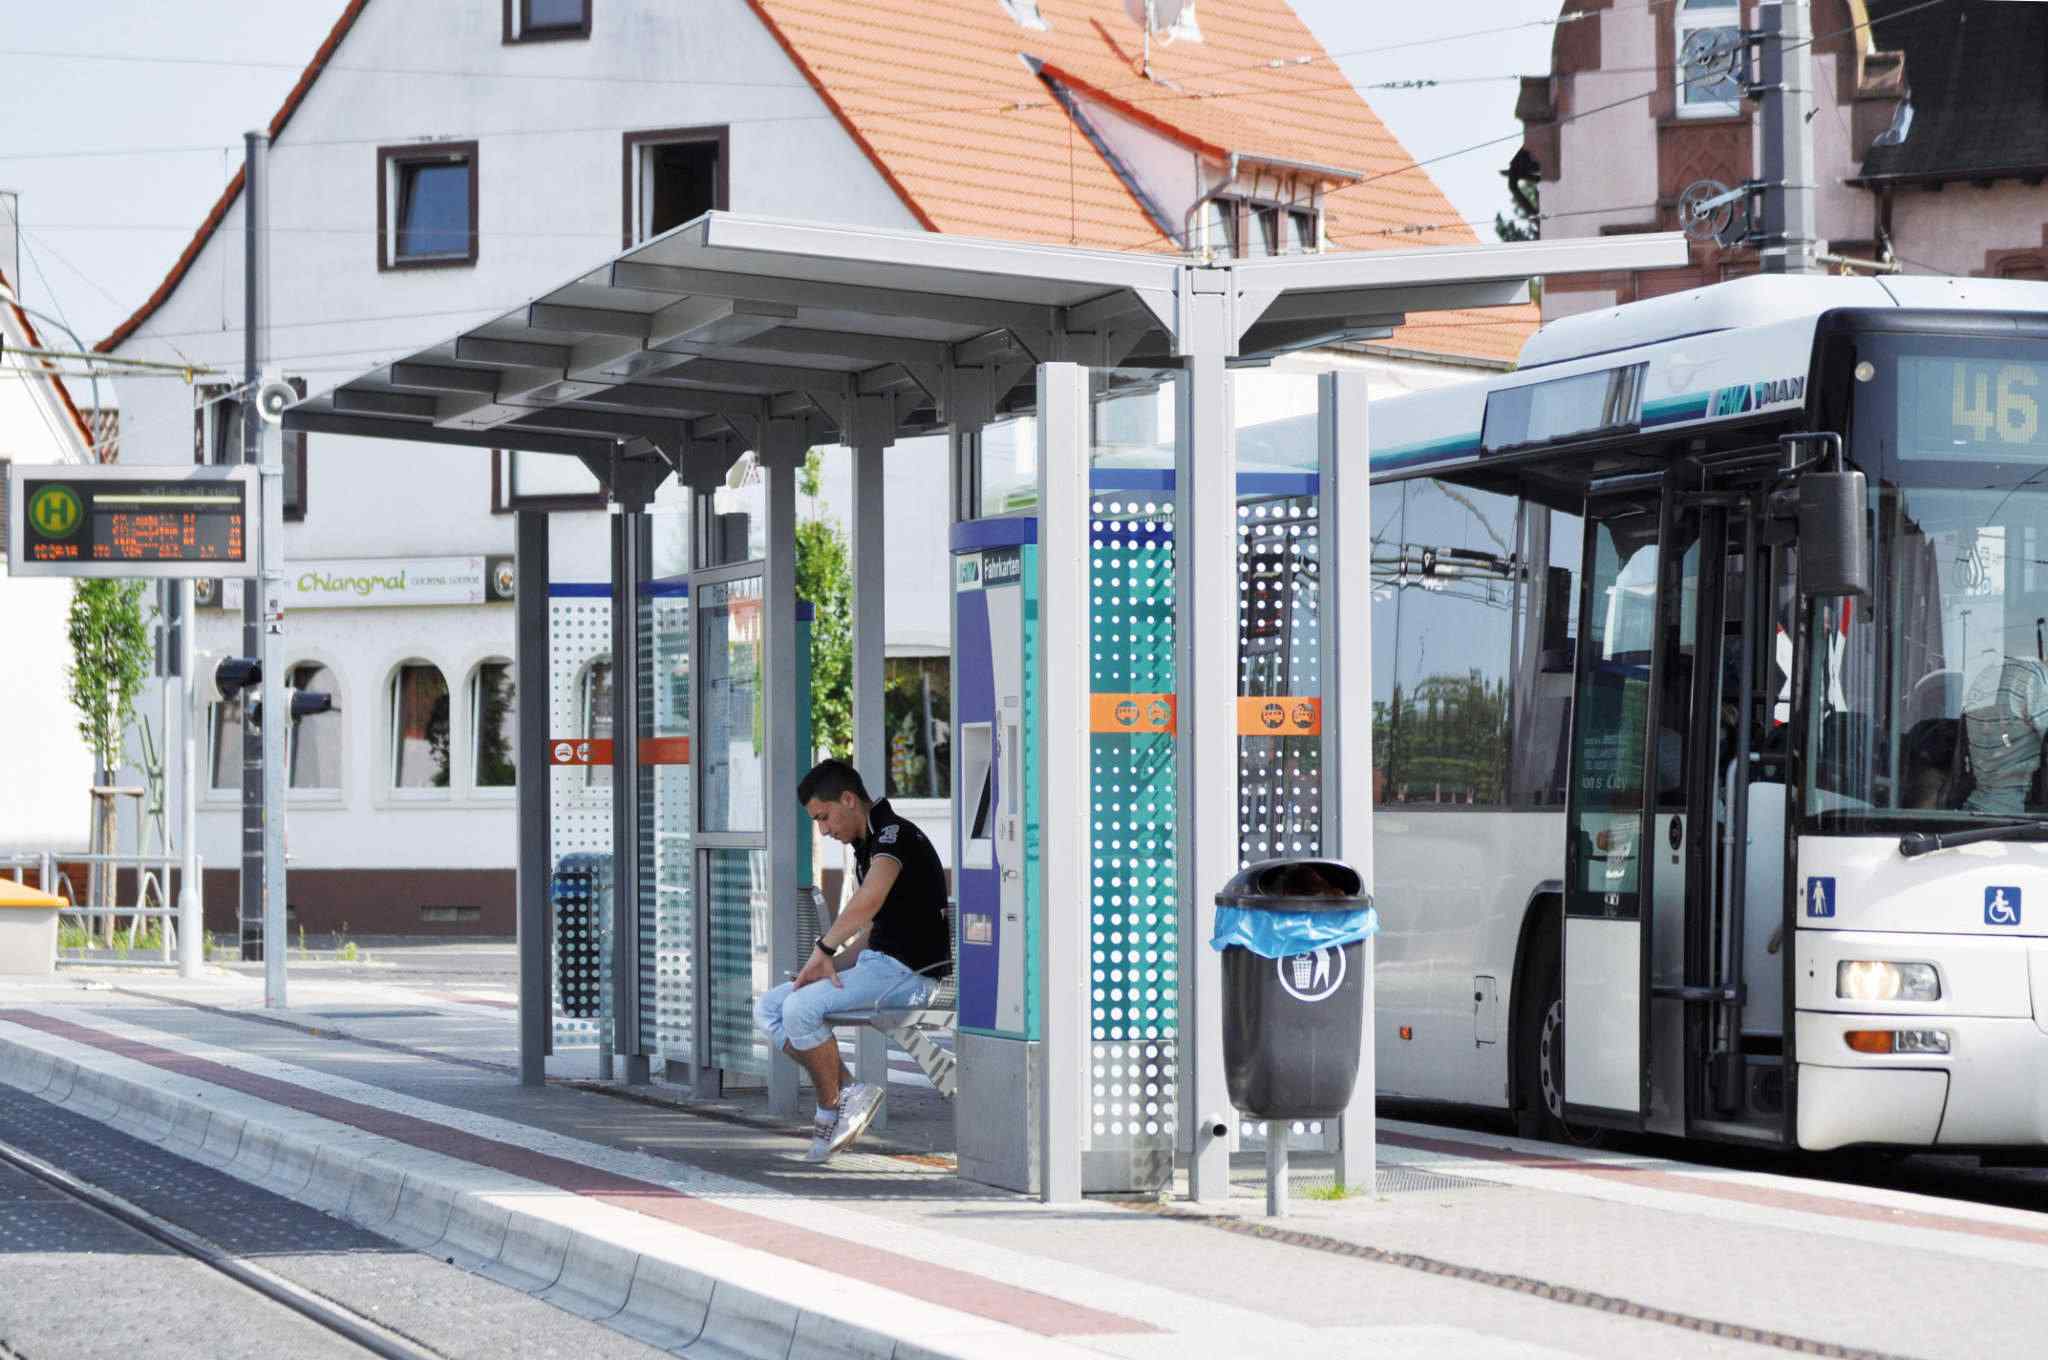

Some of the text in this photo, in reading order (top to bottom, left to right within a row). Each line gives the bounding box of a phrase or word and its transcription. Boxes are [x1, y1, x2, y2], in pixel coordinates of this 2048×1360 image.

[1763, 376, 1804, 404] MAN
[1952, 362, 2039, 443] 46
[984, 556, 1020, 580] Fahrkarten
